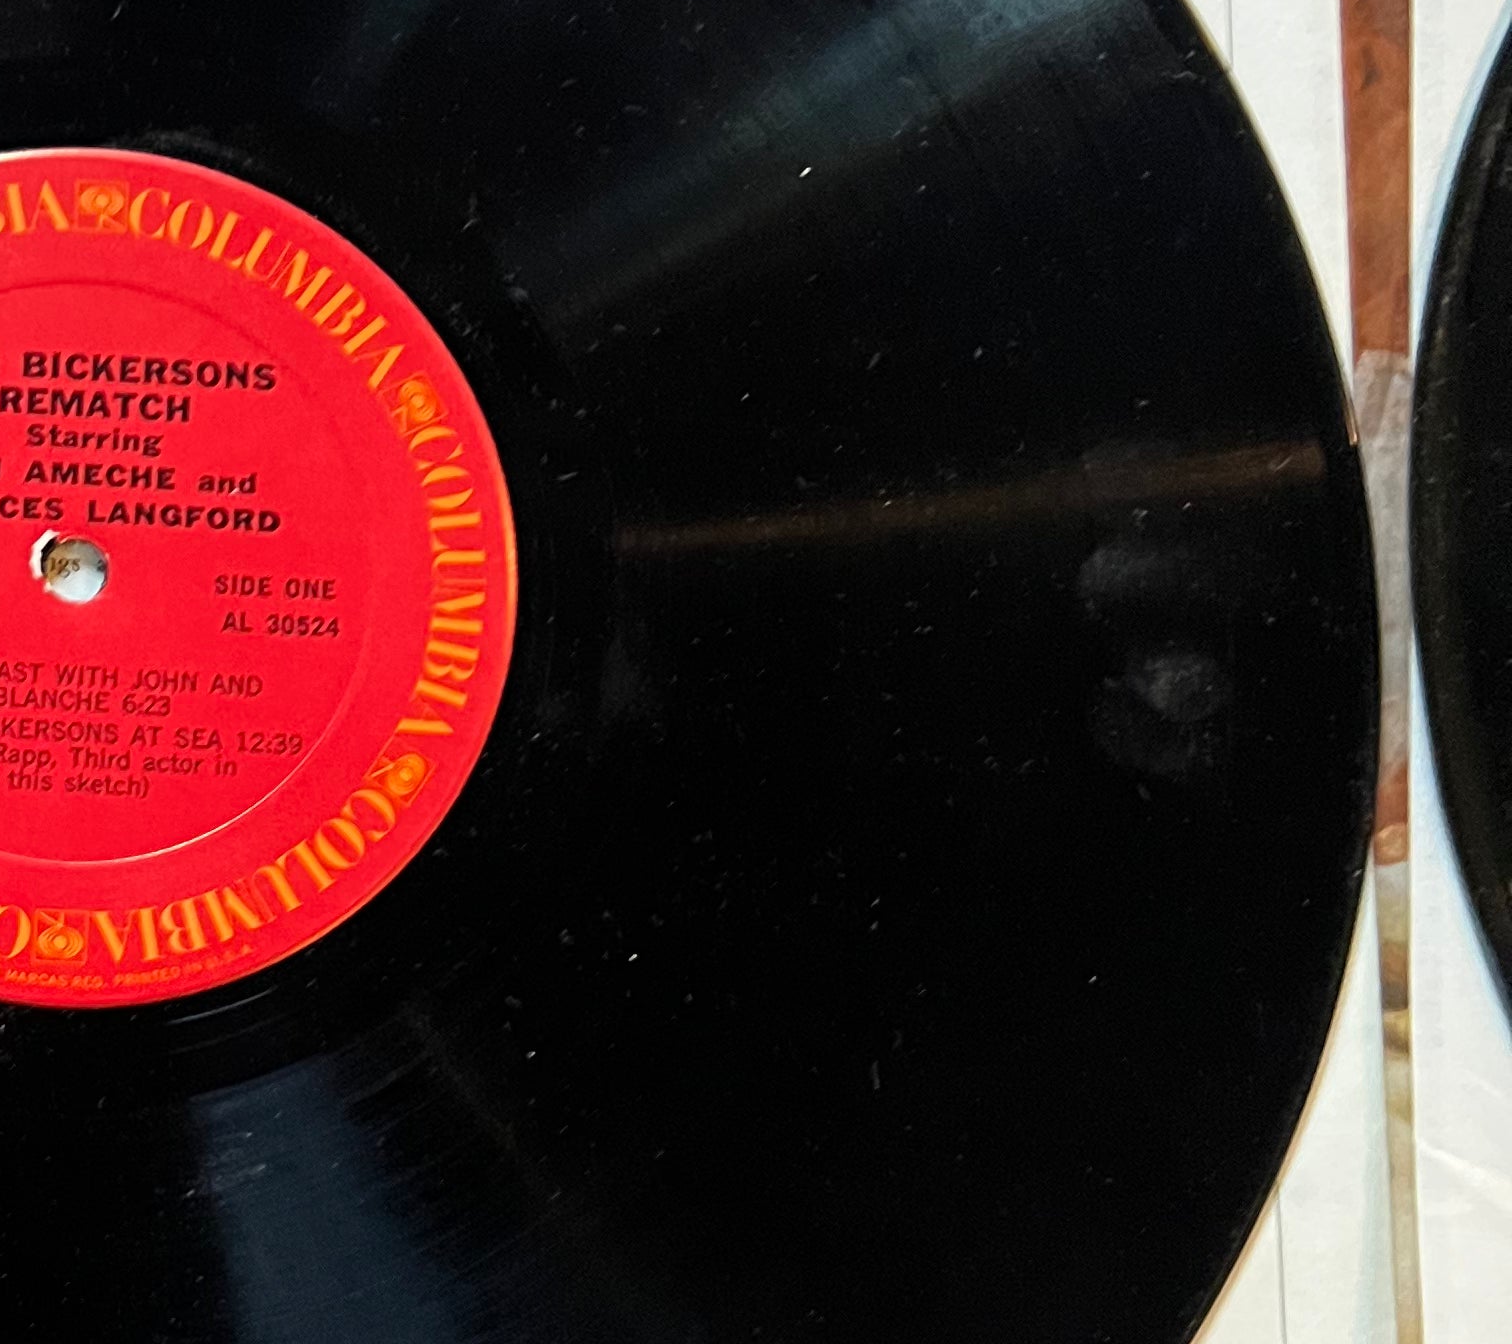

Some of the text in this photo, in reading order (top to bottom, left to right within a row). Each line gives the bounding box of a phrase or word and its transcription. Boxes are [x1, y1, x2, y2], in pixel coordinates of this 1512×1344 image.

[129, 186, 412, 389] COLUMBIA
[23, 352, 275, 390] BICKERSONS
[0, 387, 190, 422] REMATCH
[27, 424, 163, 458] Starring
[25, 461, 175, 490] AMECHE
[198, 474, 256, 494] and
[88, 500, 280, 532] LANGFORD
[215, 575, 336, 600] SIDE ONE
[401, 428, 486, 734] COLUMBIA
[221, 612, 339, 637] AL 30524
[56, 664, 118, 689] WITH
[131, 669, 198, 694] JOHN
[209, 674, 262, 697] AND
[122, 694, 170, 717] 6:23
[130, 725, 163, 746] AT
[174, 728, 222, 752] SEA
[238, 732, 303, 755] 12:39
[69, 747, 132, 777] Third
[142, 753, 204, 778] actor
[215, 754, 237, 776] in
[7, 769, 149, 798] this sketch)
[98, 783, 397, 963] COLUMBIA
